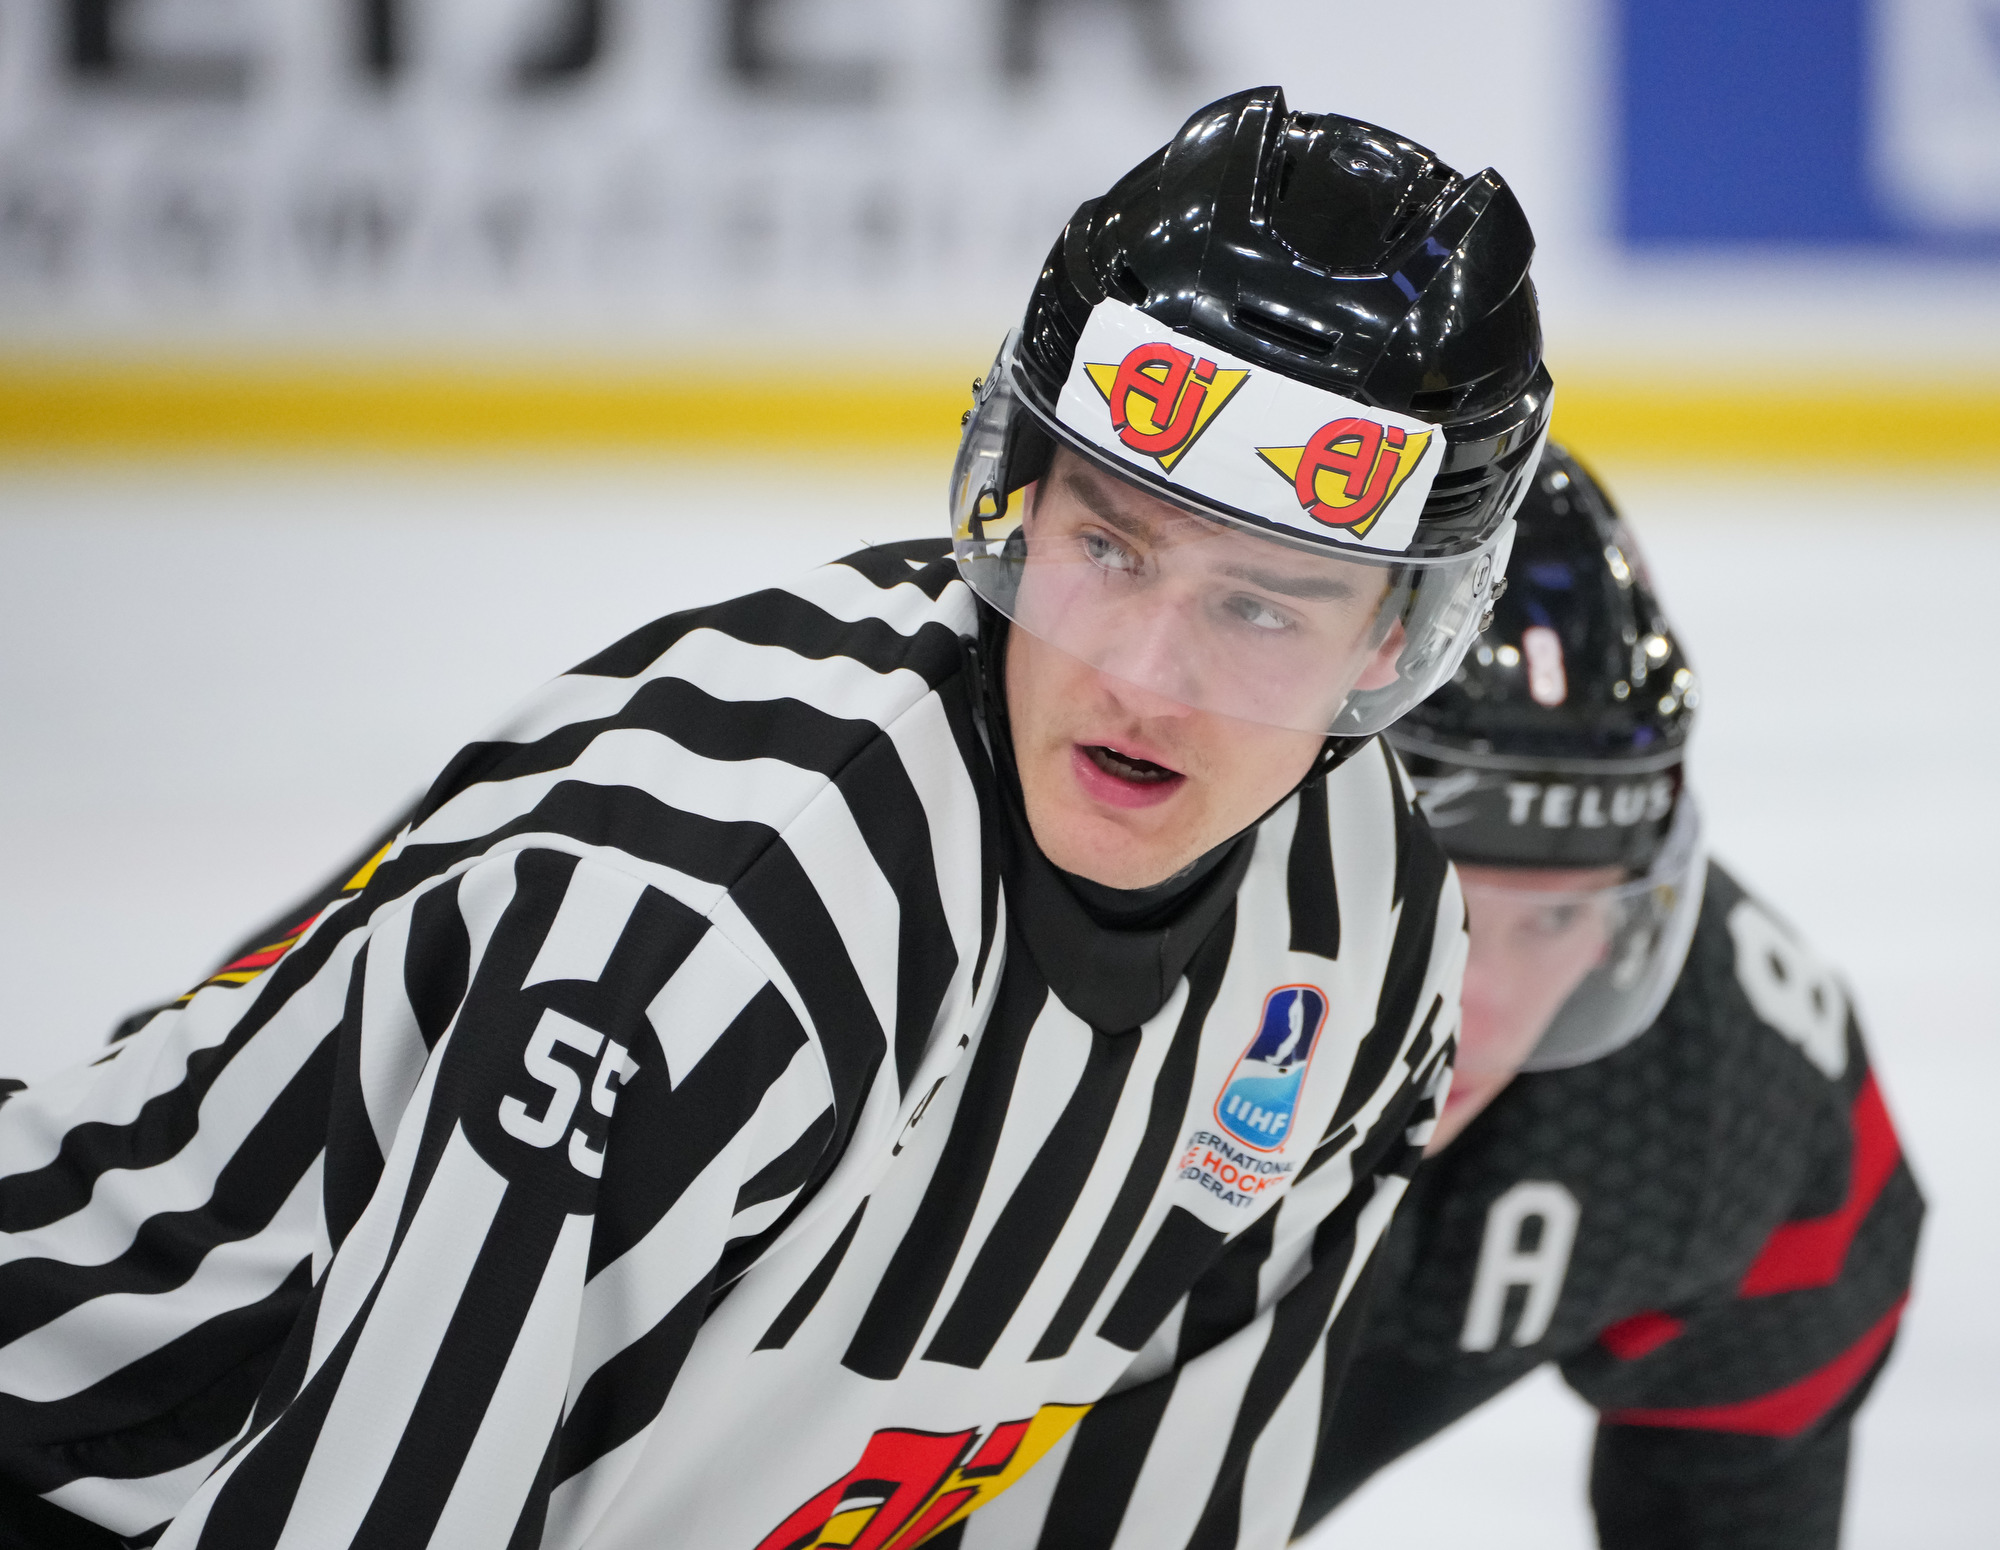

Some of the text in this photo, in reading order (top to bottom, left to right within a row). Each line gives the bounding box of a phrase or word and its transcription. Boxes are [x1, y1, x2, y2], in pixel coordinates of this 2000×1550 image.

[1110, 342, 1217, 457] Aj
[1295, 417, 1406, 528] Aj
[1226, 1095, 1289, 1135] IIHF
[1460, 1180, 1582, 1353] A
